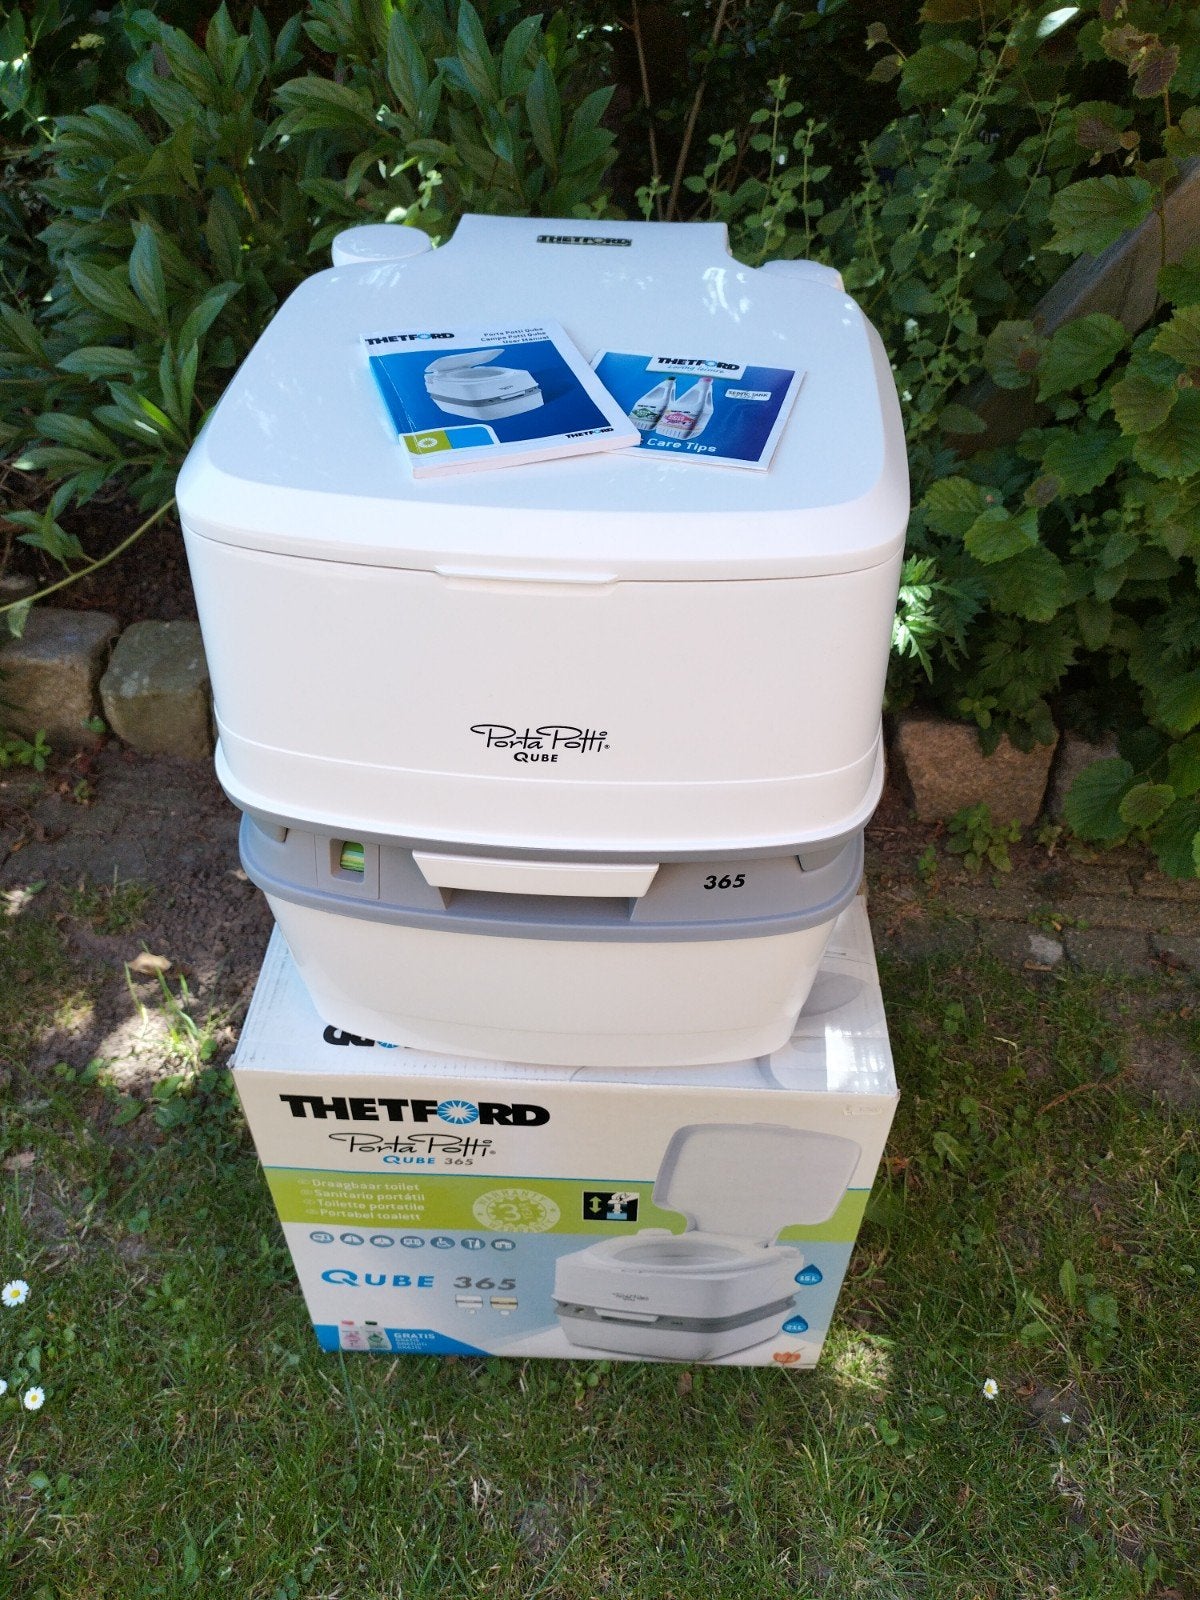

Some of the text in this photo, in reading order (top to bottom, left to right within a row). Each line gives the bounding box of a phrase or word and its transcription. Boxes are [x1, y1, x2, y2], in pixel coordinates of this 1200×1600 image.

[537, 235, 631, 246] THETFORD
[364, 332, 455, 345] THETFORD
[657, 357, 740, 371] THETFORD
[565, 428, 614, 439] THETFORD
[646, 438, 681, 449] Care
[686, 441, 717, 453] Tips
[470, 724, 543, 749] Porta
[513, 752, 559, 763] QUBE
[703, 874, 746, 890] 365
[279, 1094, 551, 1127] THETFORD
[328, 1132, 416, 1153] Porta
[383, 1155, 473, 1166] QUBE 365
[312, 1179, 382, 1191] Draagbaar
[384, 1182, 420, 1191] toilet
[314, 1189, 374, 1200] Sanitario
[320, 1208, 374, 1219] Portabel
[377, 1212, 421, 1222] toalett
[321, 1269, 517, 1291] QUBE 365
[394, 1332, 435, 1340] GRATIS
